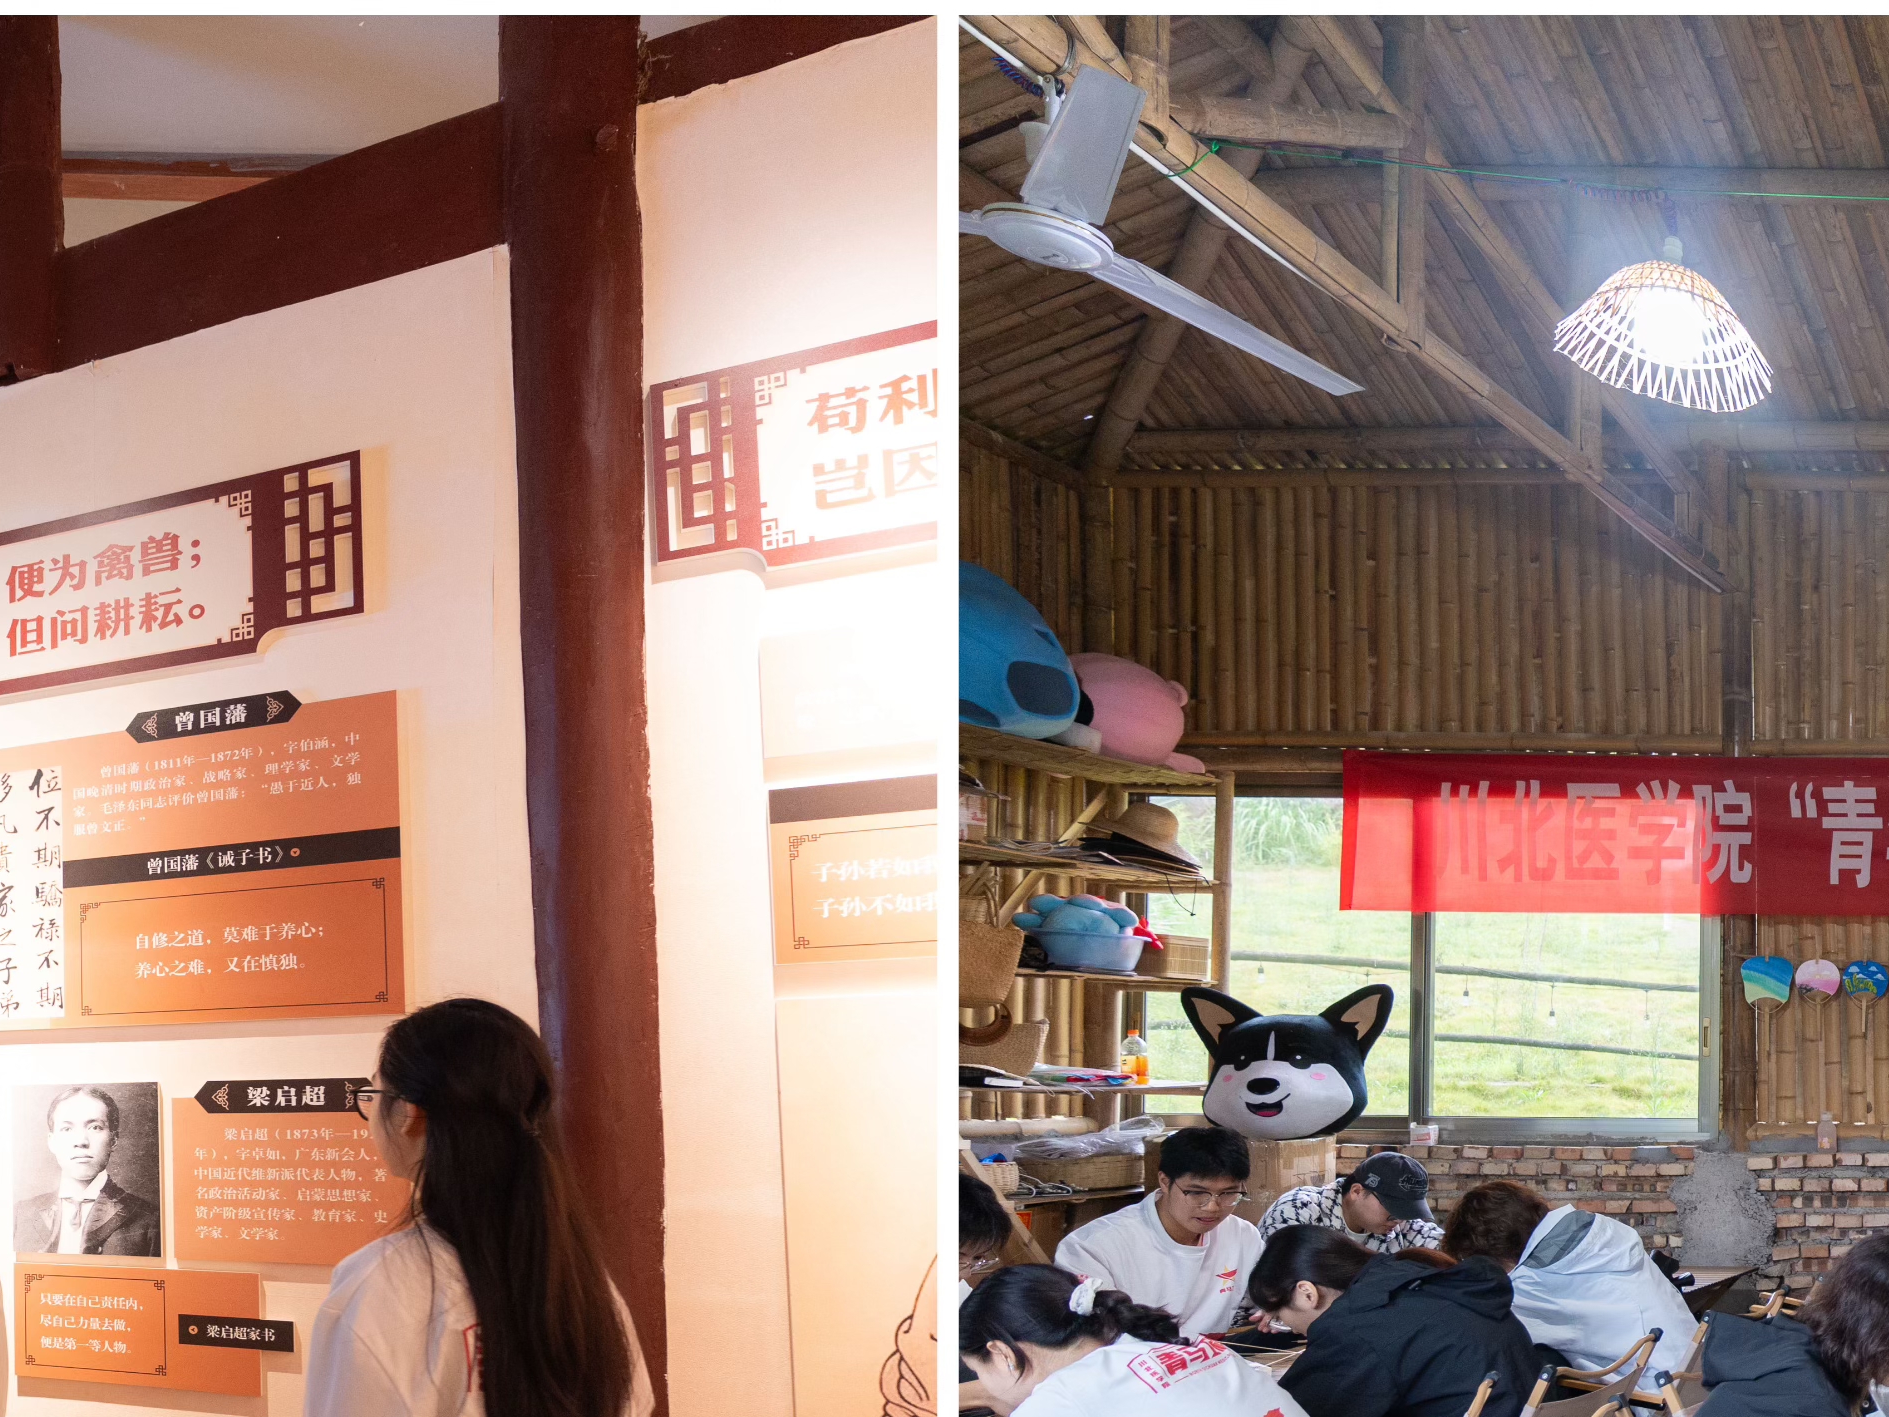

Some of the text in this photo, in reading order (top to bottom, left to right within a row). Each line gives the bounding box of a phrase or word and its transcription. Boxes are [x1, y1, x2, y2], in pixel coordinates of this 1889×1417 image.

[812, 441, 938, 510] 岂因
[175, 702, 248, 733] 曾国藩
[147, 844, 285, 876] 曾国藩《诫子书》
[134, 920, 326, 952] 自修之道，莫难于养心；
[133, 952, 307, 980] 养心之难，又在慎独。
[246, 1085, 326, 1107] 梁启超
[224, 1127, 373, 1142] 梁启超（1873年—19
[39, 1292, 145, 1312] 只要在自己责任内，
[39, 1314, 132, 1333] 尽自己力量去做，
[205, 1323, 276, 1342] 梁启超家书
[40, 1335, 133, 1354] 便是第一等人物。
